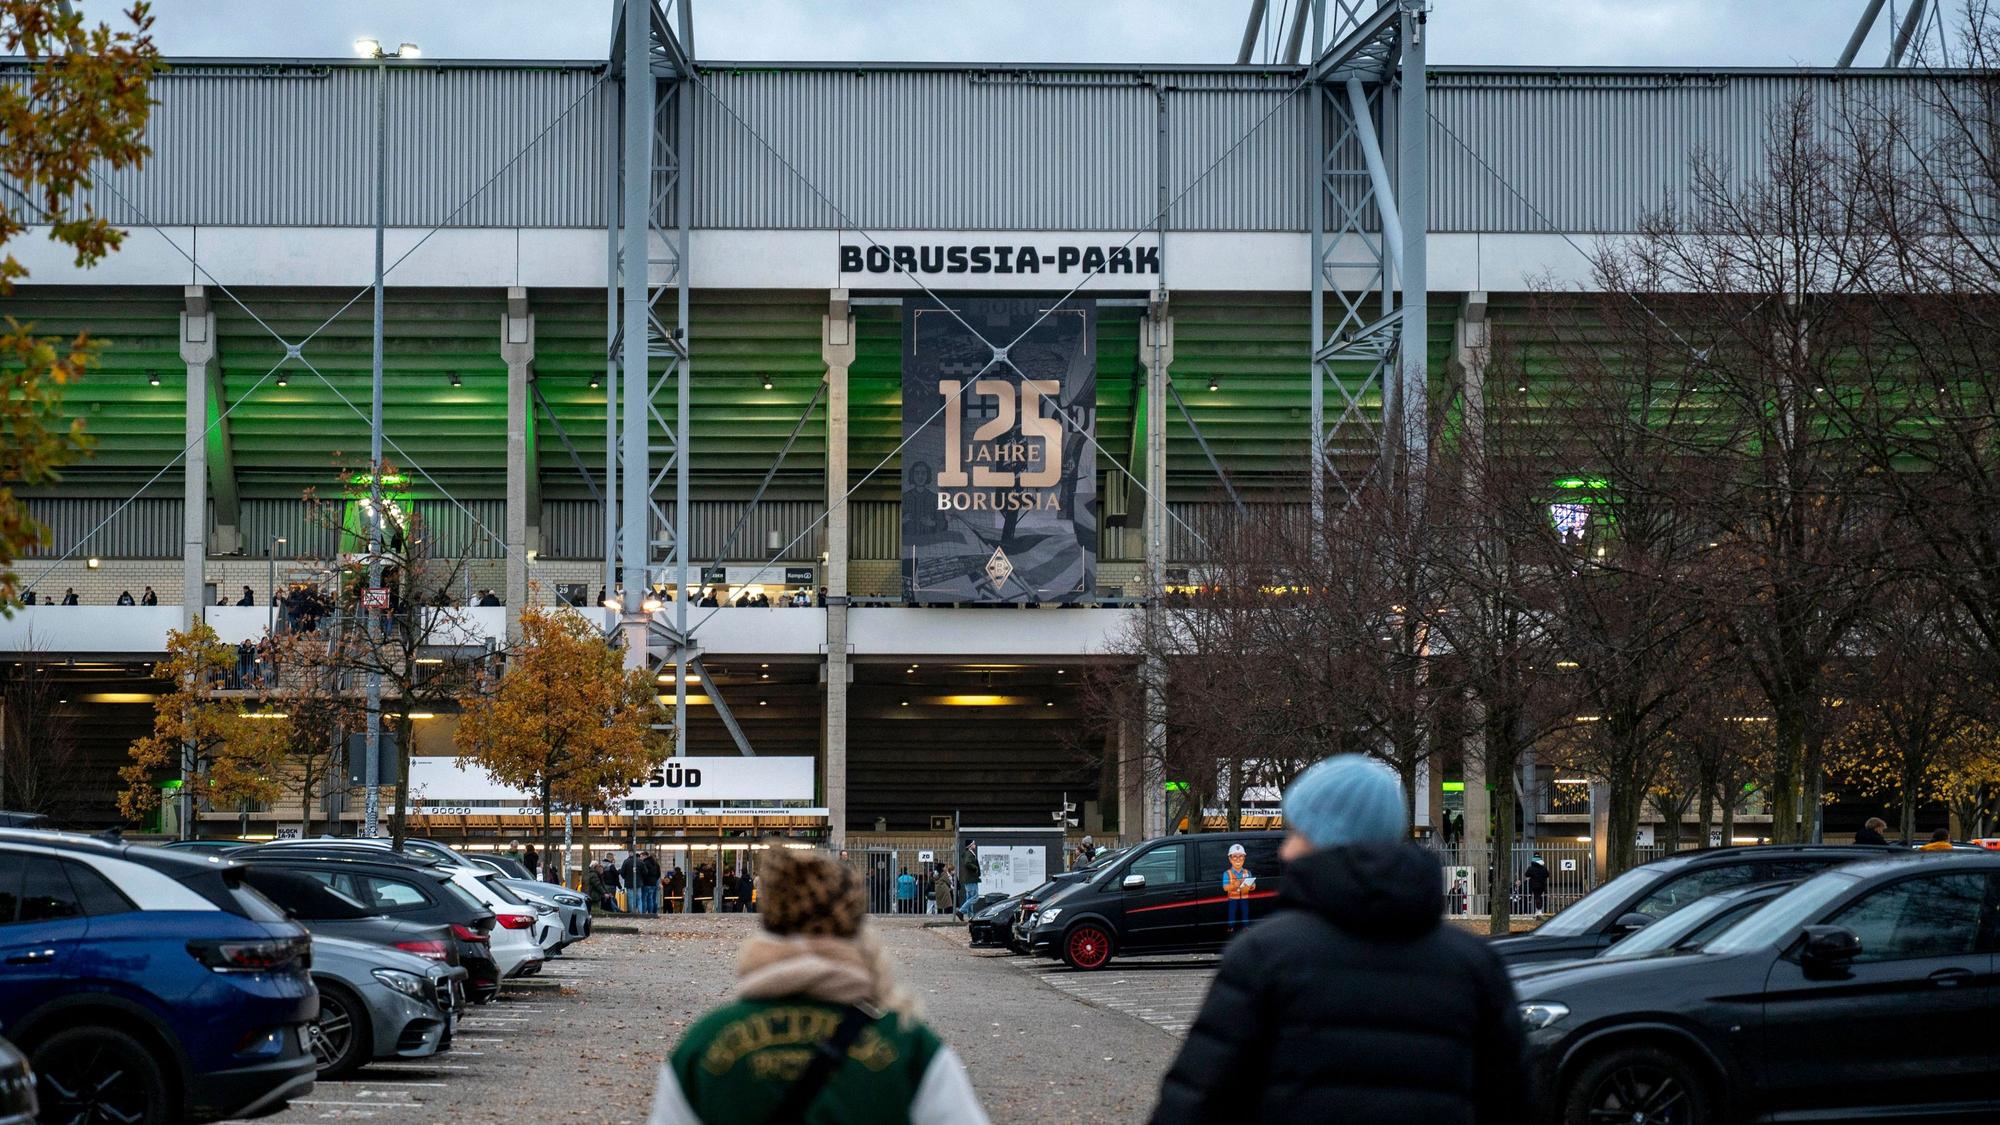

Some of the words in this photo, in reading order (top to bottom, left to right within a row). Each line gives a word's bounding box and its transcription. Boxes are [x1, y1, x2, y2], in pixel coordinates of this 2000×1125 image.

[840, 245, 1159, 273] BORUSSIA-PARK
[938, 380, 1062, 487] 125
[965, 444, 1041, 462] JAHRE
[937, 491, 1061, 511] BORUSSIA
[560, 586, 569, 594] 29
[649, 763, 701, 788] SÜD
